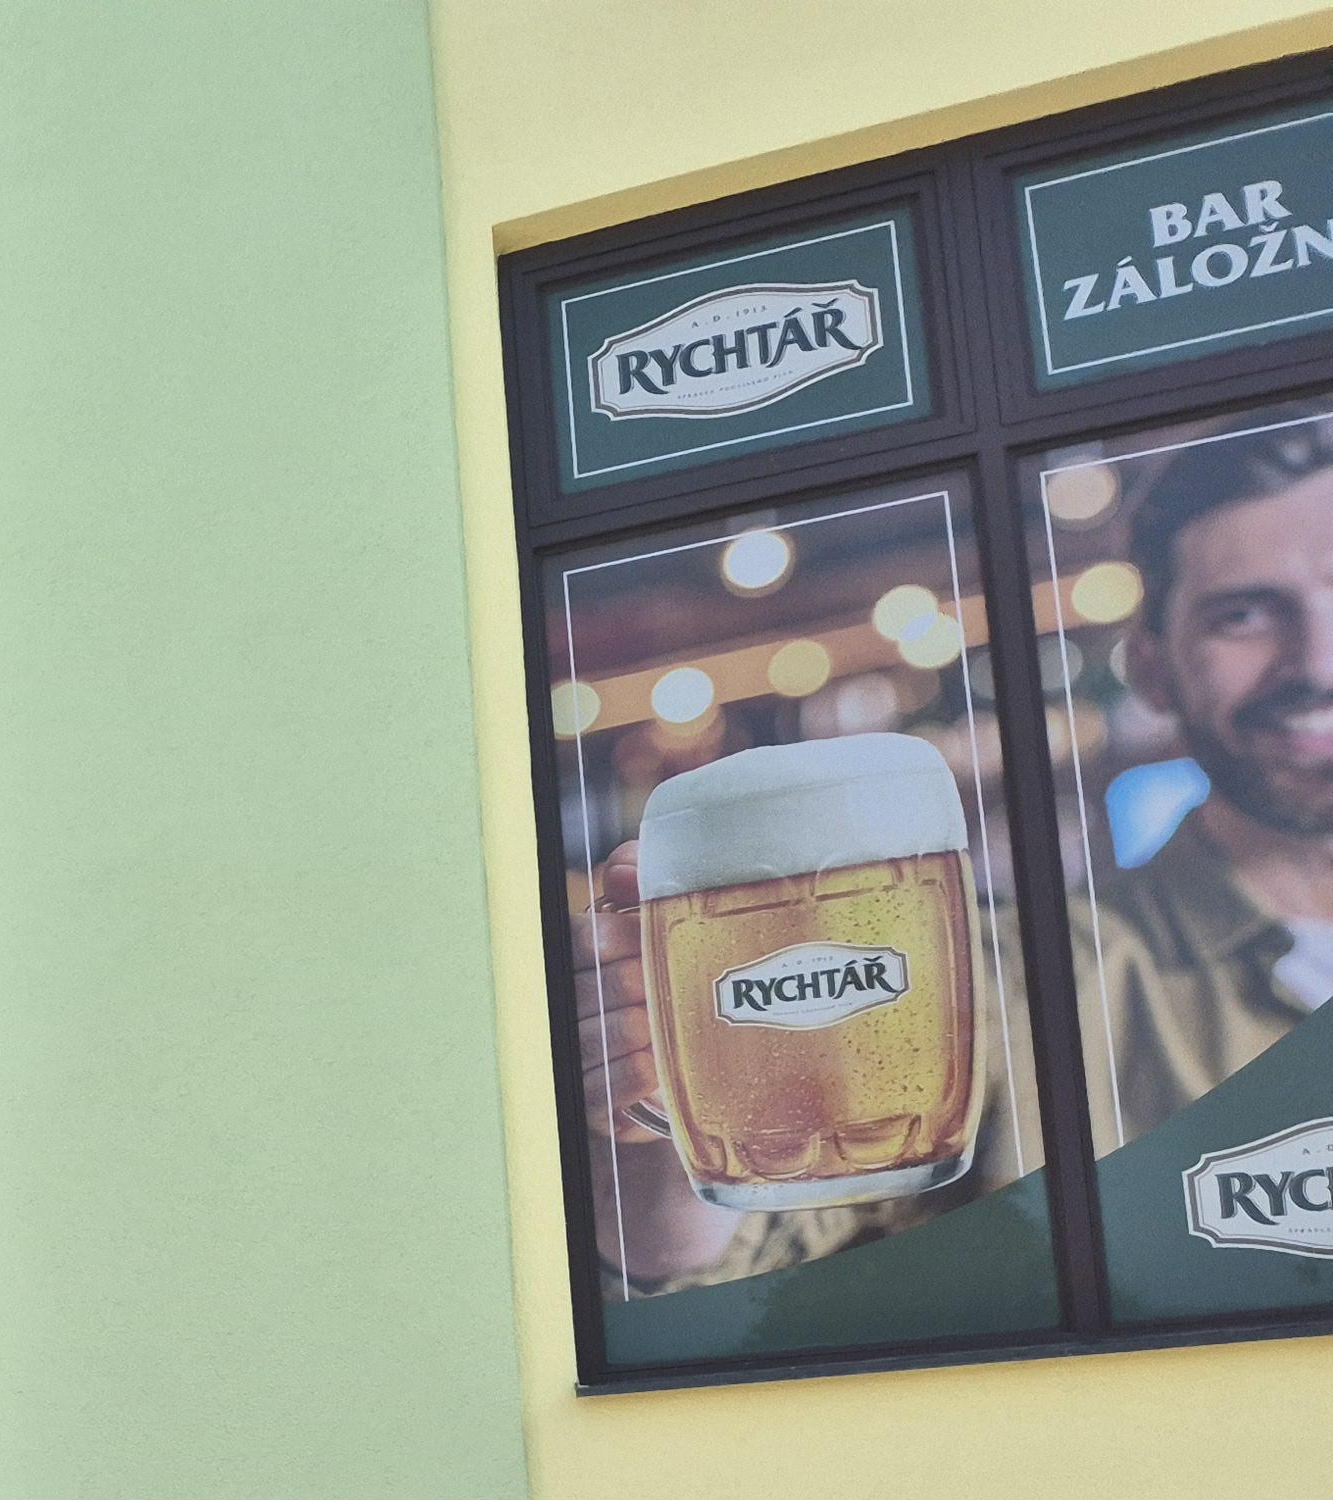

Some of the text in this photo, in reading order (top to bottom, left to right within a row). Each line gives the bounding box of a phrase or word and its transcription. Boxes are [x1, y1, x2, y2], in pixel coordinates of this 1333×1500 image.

[1149, 180, 1292, 248] BAR
[615, 298, 863, 396] RYCHTÁŘ
[731, 955, 899, 1012] RYCHTÁŘ
